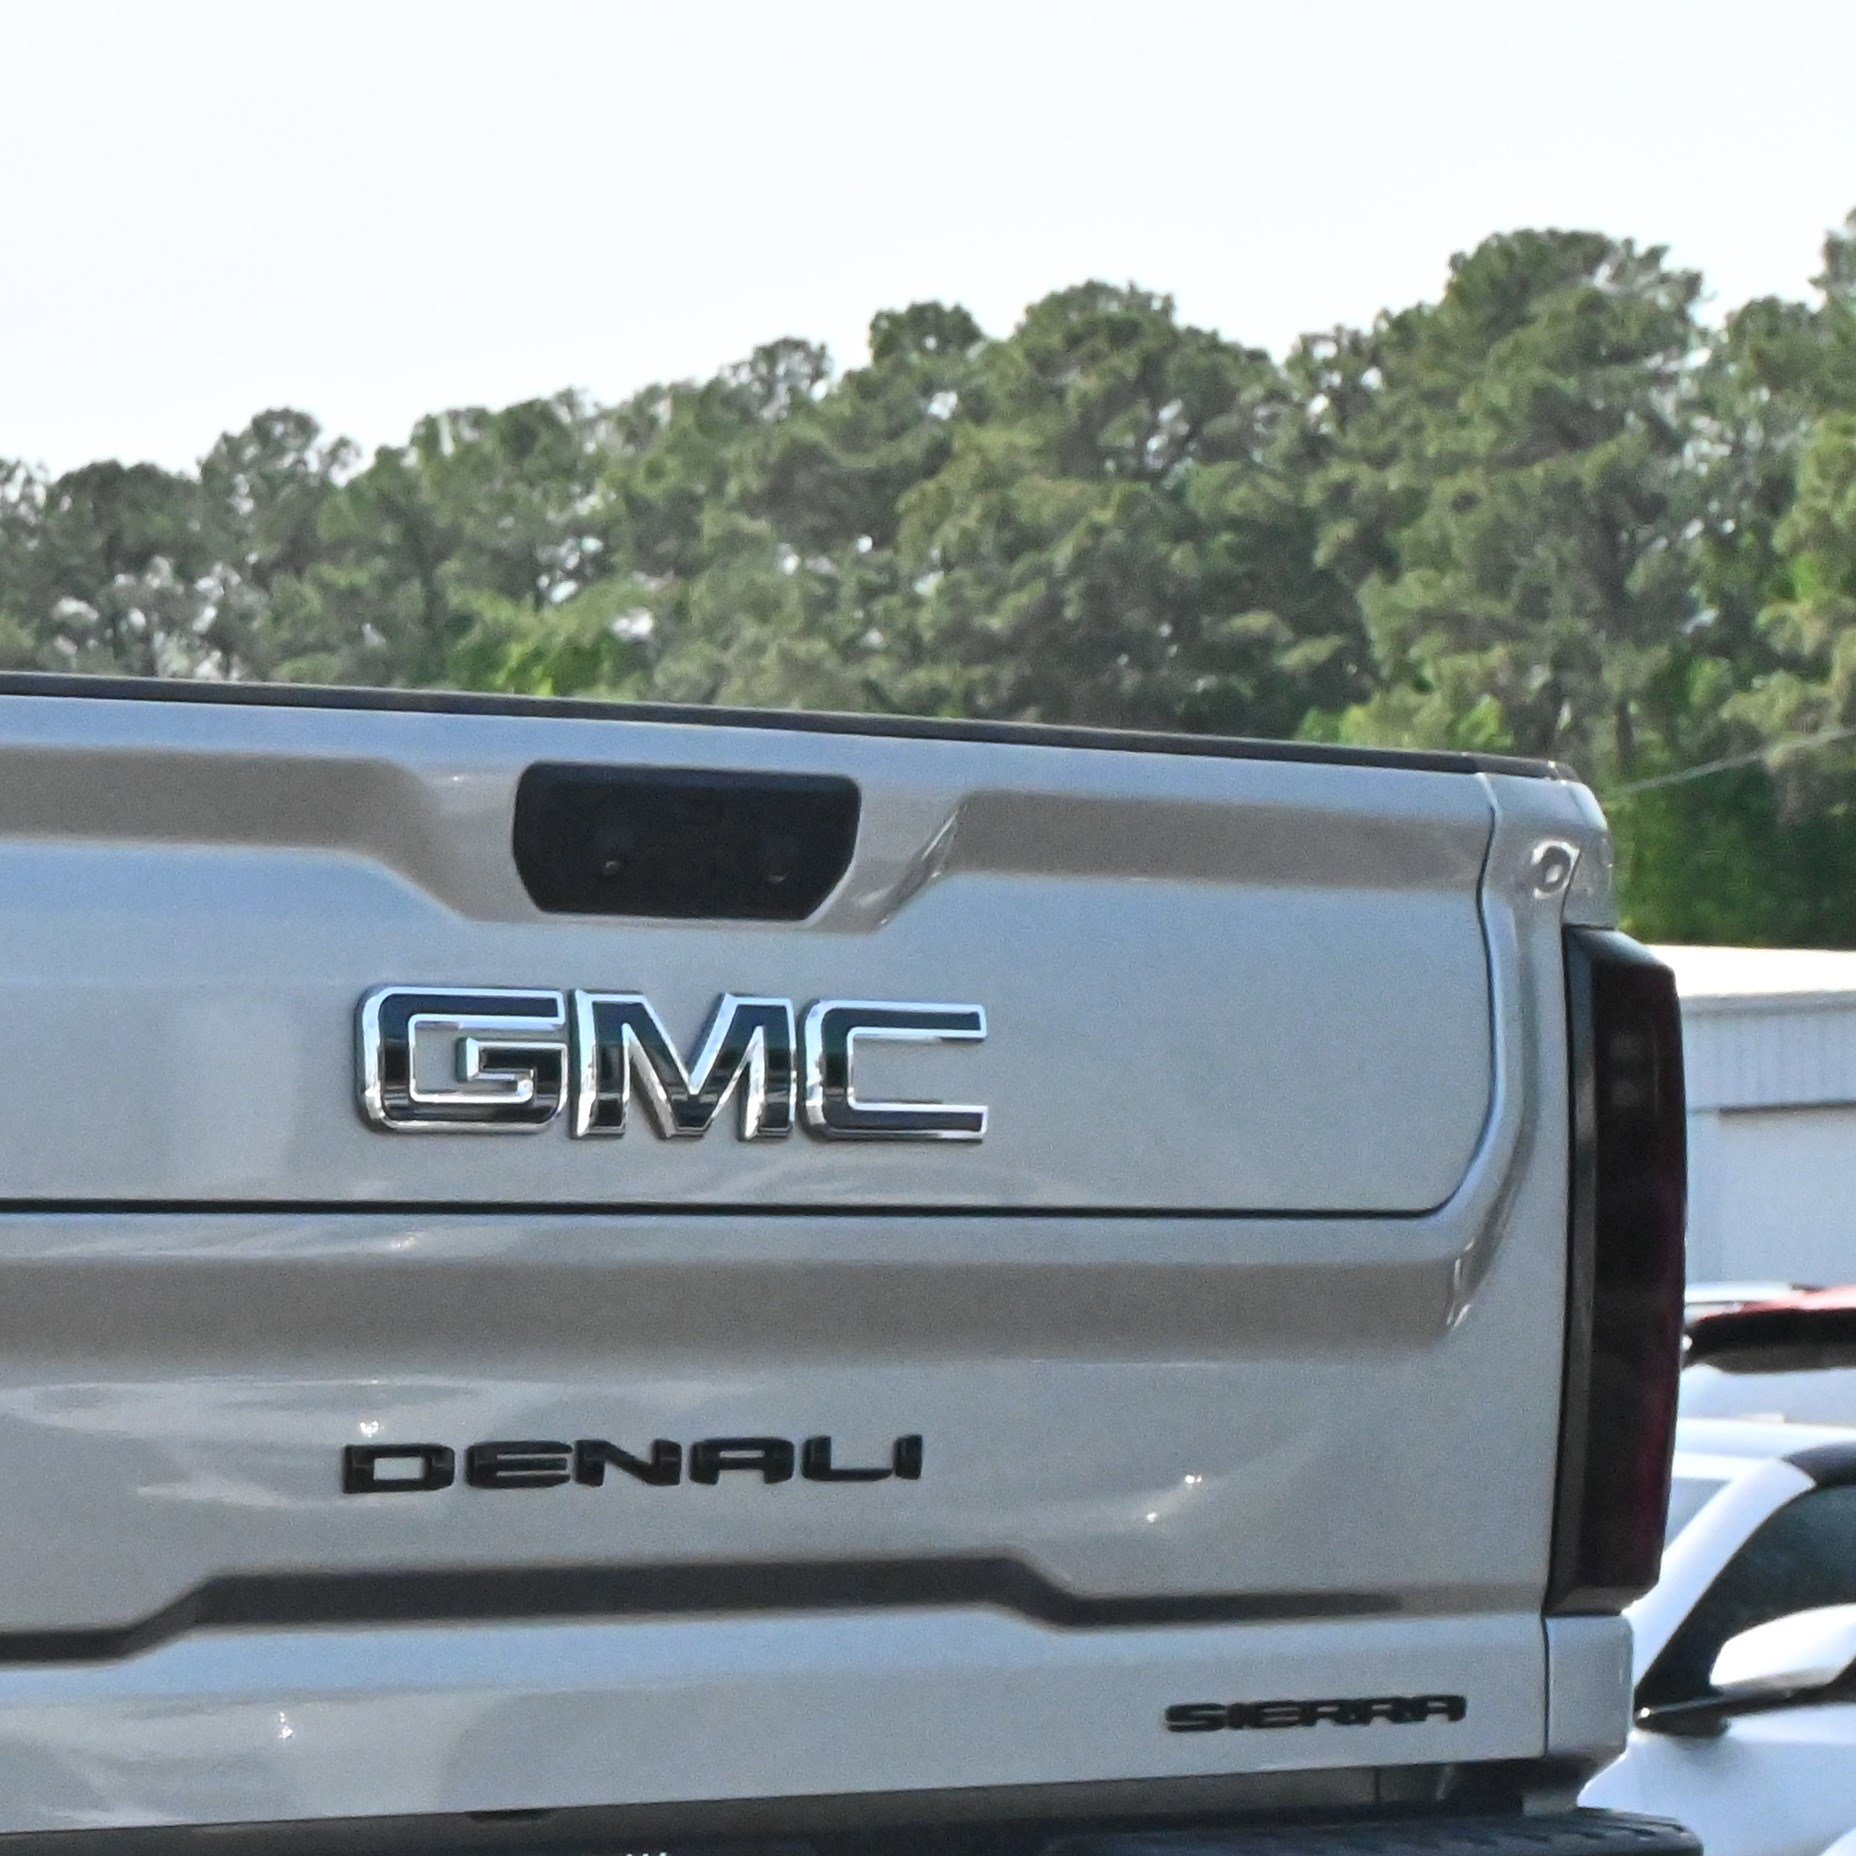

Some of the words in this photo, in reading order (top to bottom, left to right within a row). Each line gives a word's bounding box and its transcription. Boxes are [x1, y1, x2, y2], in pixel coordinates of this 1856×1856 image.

[356, 984, 989, 1143] GMC
[343, 1434, 924, 1494] DENALI
[1165, 1694, 1467, 1732] SIERRA
